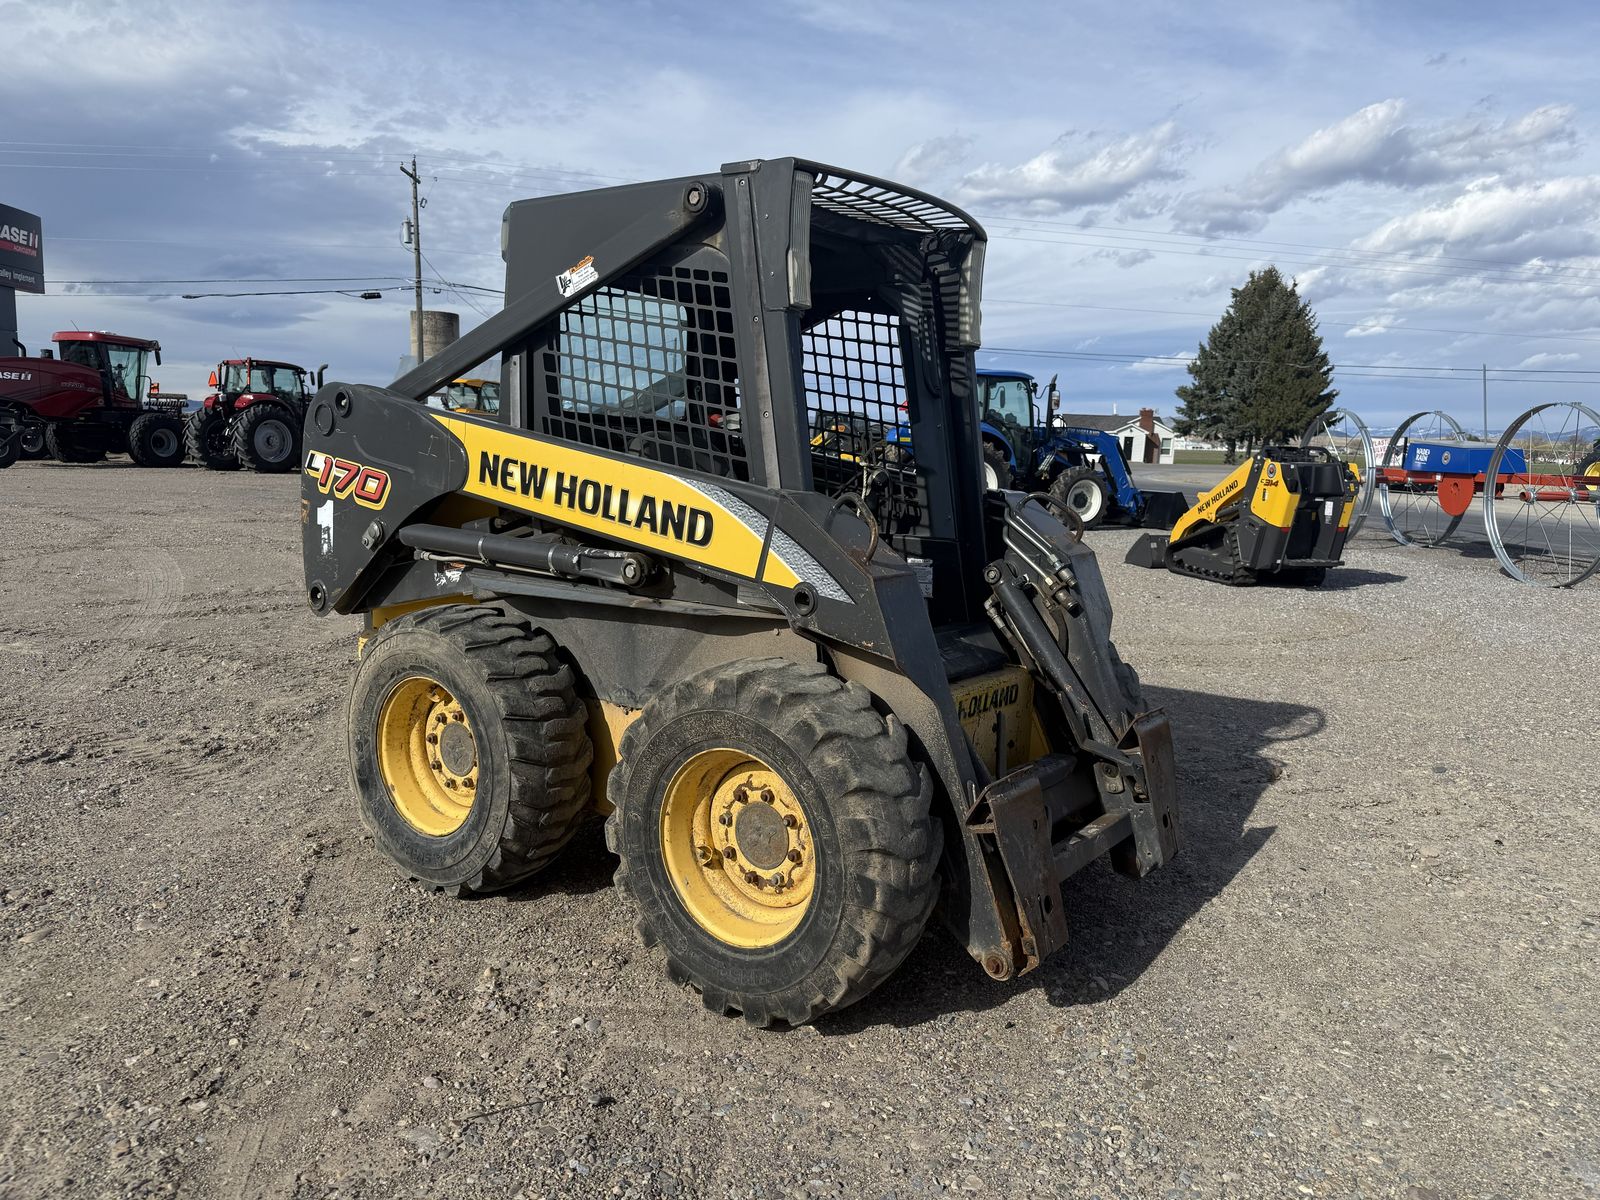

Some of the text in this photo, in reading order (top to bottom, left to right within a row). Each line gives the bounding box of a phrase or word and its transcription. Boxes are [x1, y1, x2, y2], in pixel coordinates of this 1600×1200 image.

[0, 224, 28, 246] ASE
[305, 450, 391, 510] L170
[479, 451, 714, 547] NEW HOLLAND
[1197, 500, 1211, 515] NEW
[1211, 479, 1239, 506] HOLLAND
